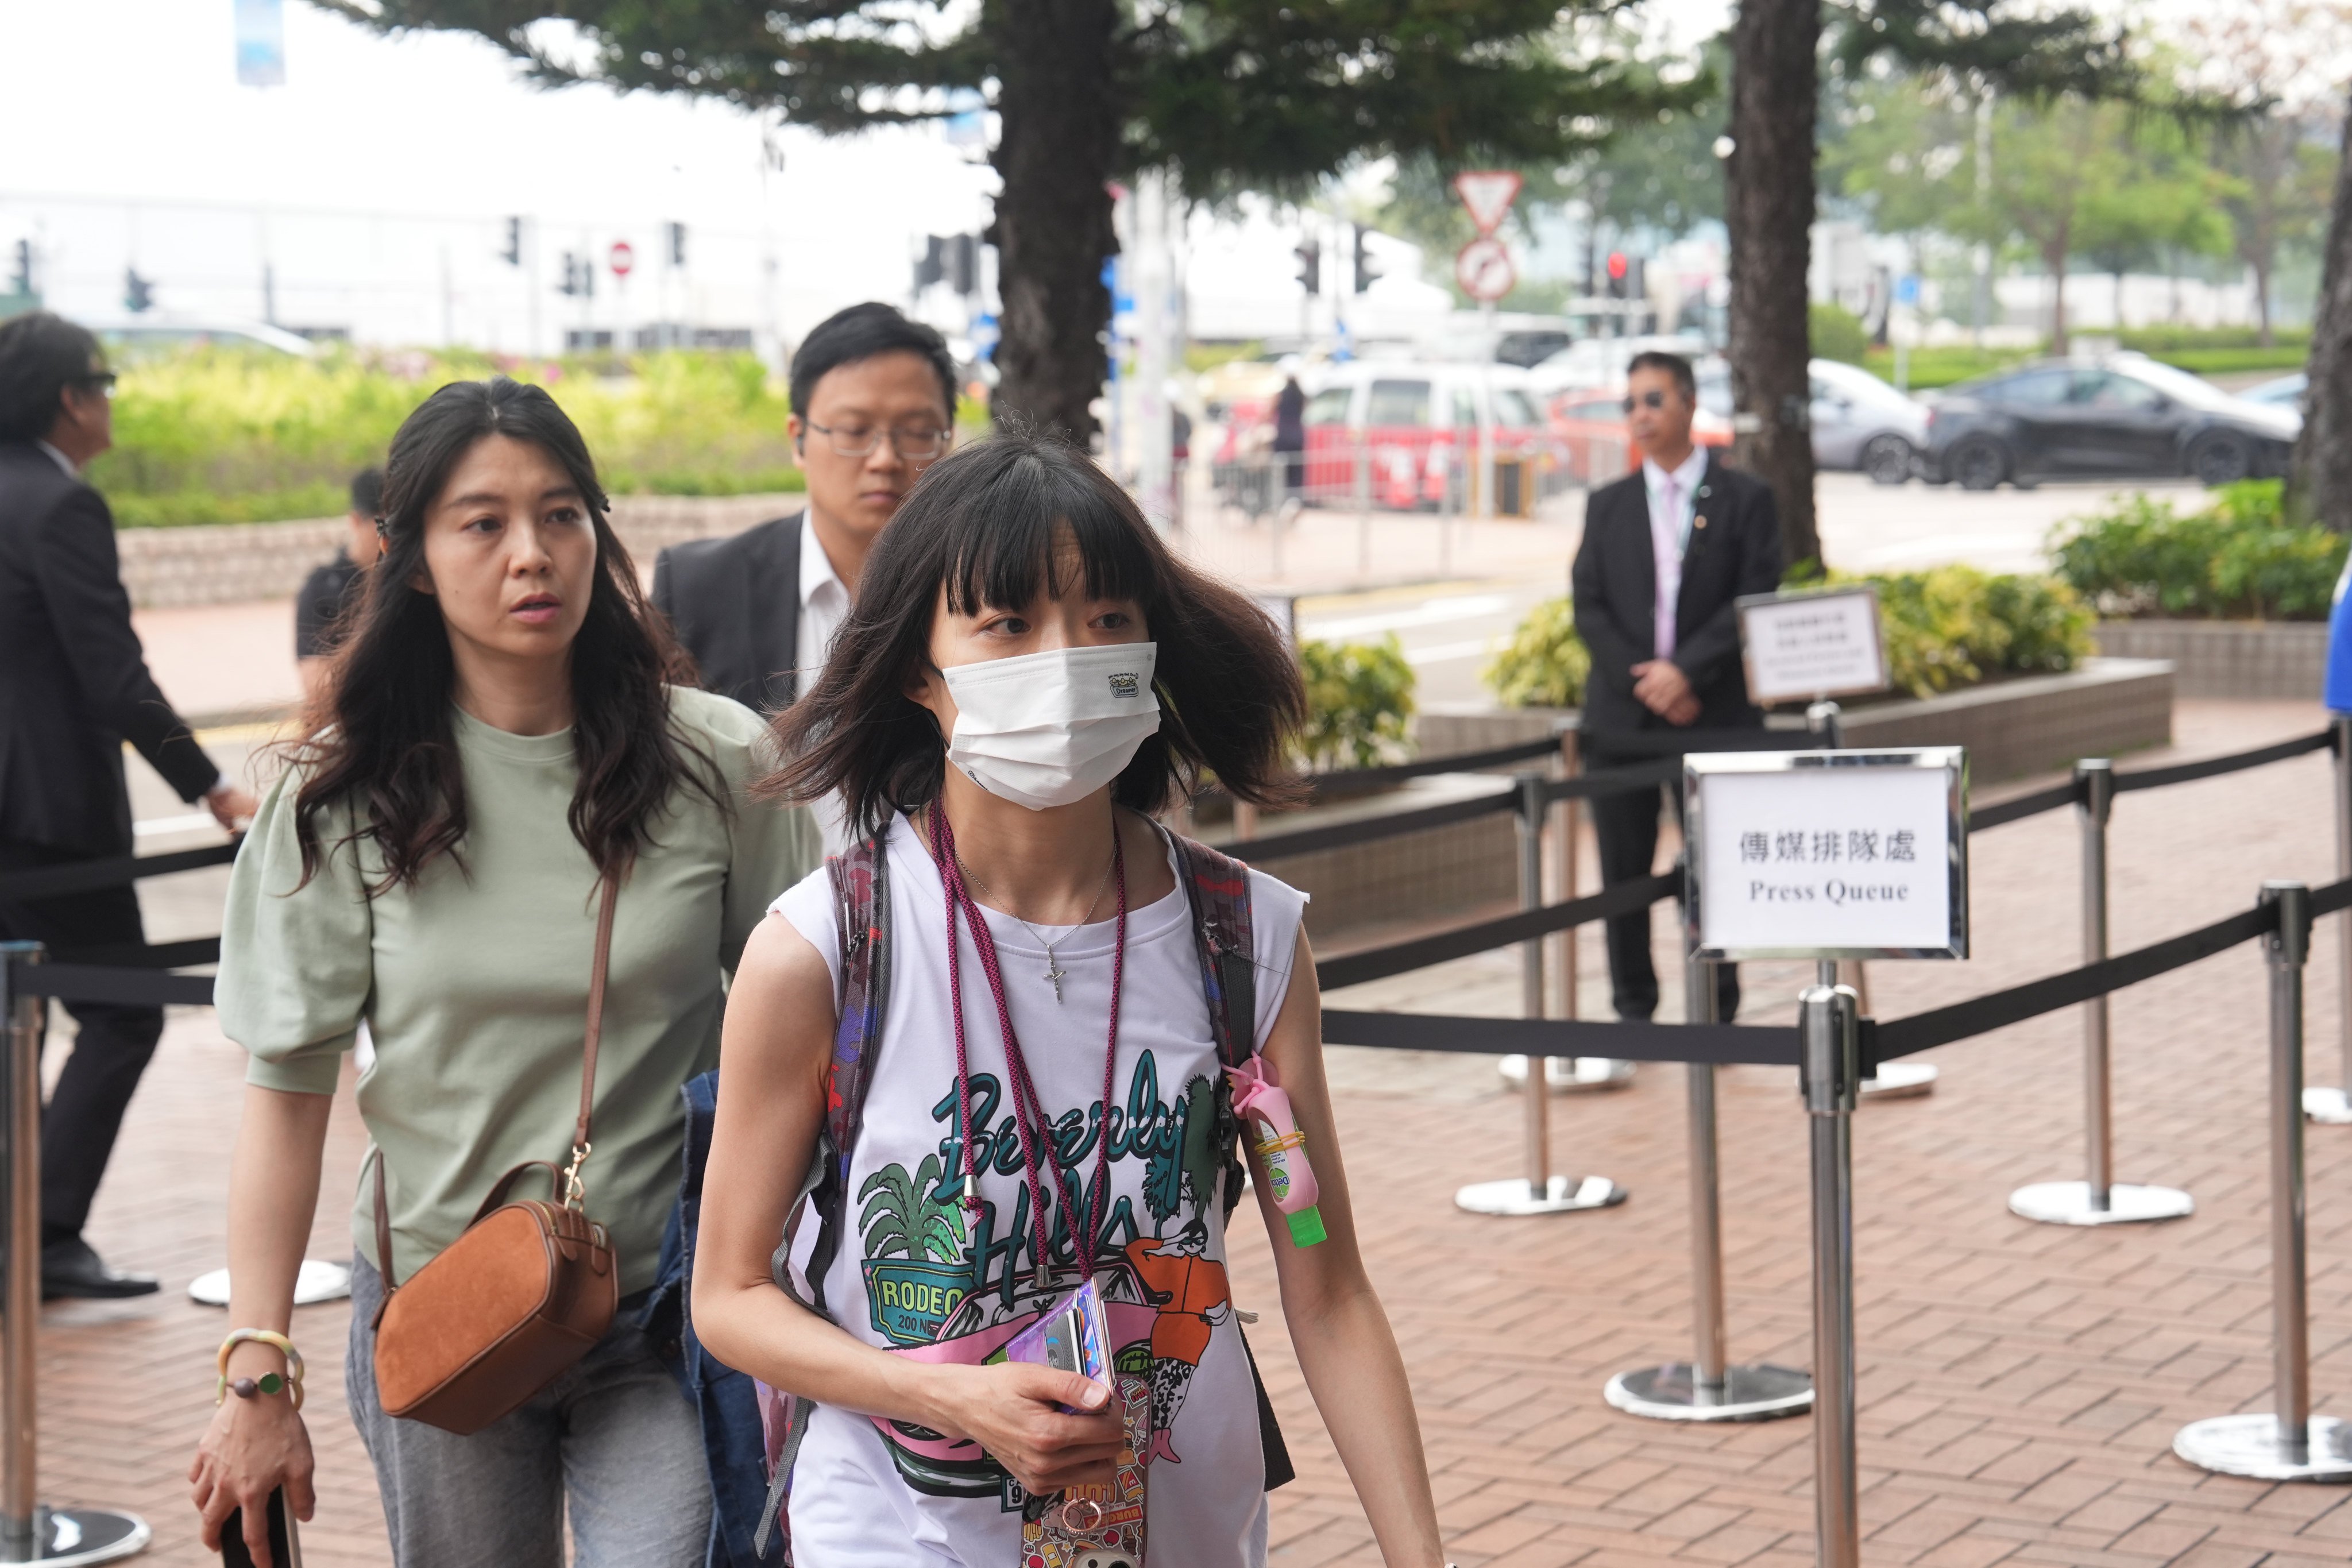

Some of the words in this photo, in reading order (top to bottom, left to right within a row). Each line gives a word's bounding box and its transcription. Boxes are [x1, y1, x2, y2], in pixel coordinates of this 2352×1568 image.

[1739, 829, 1916, 864] 傳媒排隊處
[1749, 880, 1815, 901] Press
[1825, 878, 1910, 905] Queue
[932, 1049, 1189, 1210] Beverly
[1270, 1176, 1289, 1188] Dettol
[880, 1280, 964, 1316] RODEO
[898, 1314, 917, 1331] 200
[1011, 1485, 1022, 1504] 9
